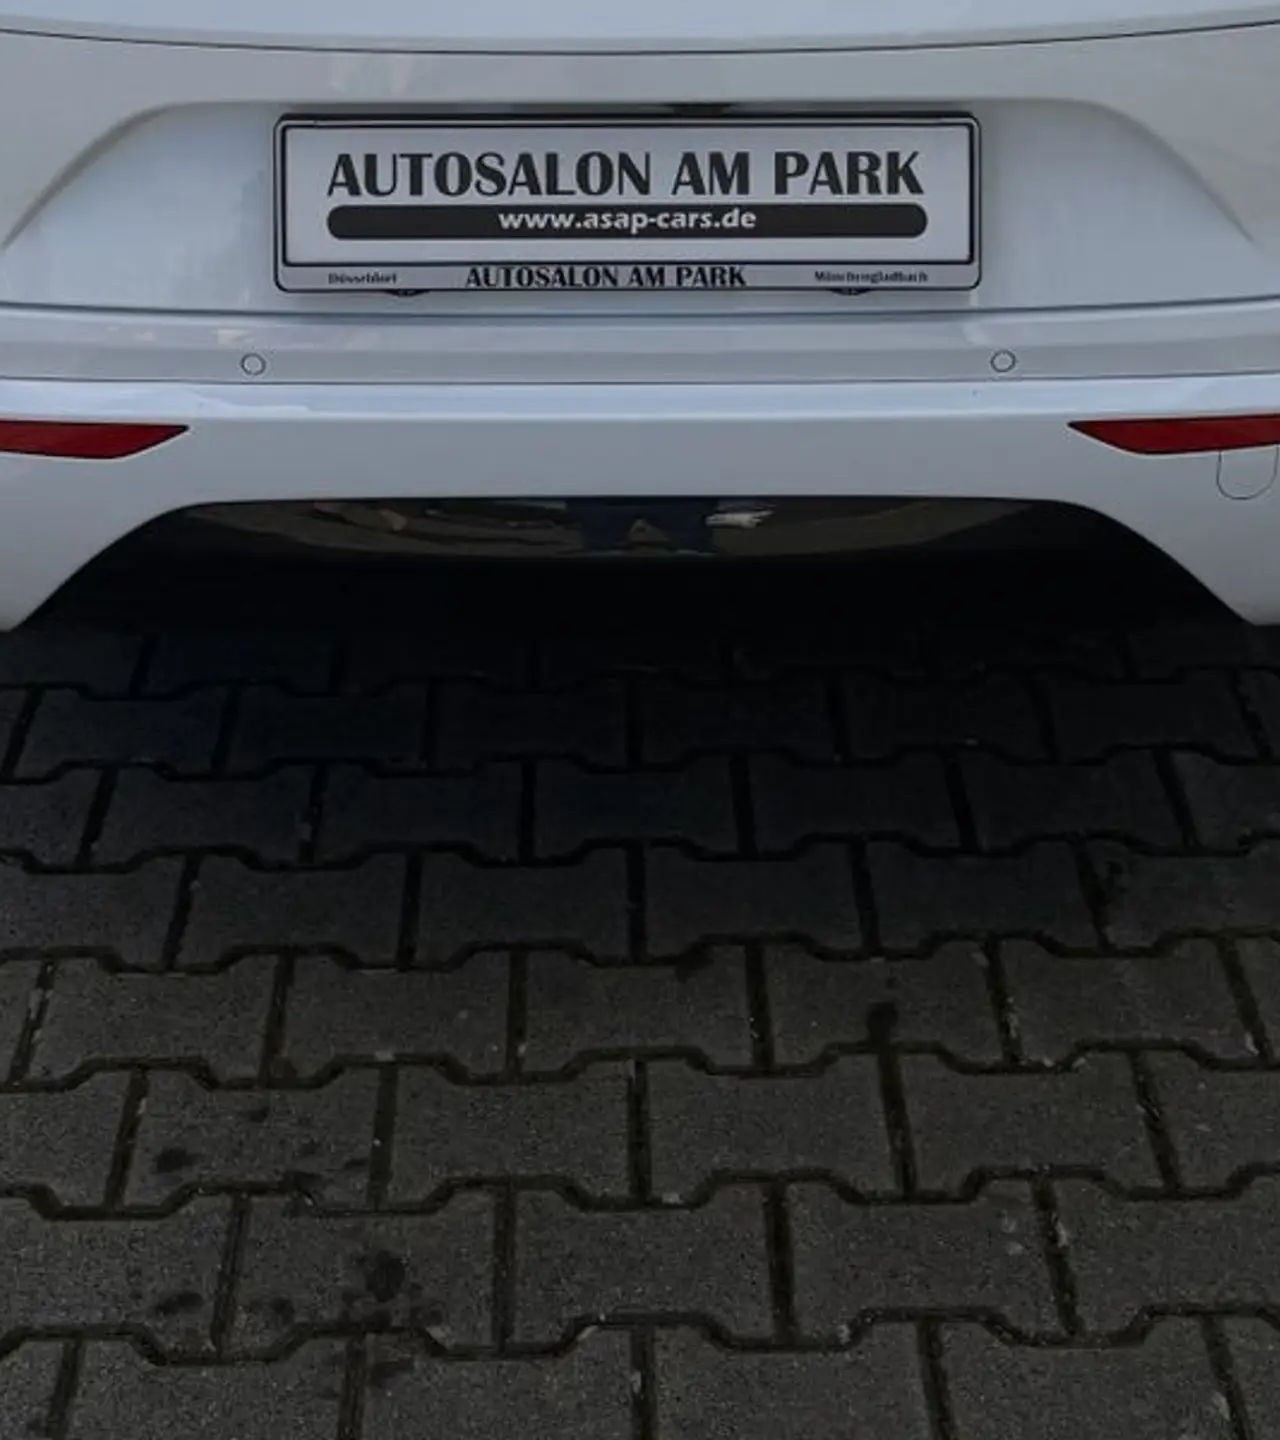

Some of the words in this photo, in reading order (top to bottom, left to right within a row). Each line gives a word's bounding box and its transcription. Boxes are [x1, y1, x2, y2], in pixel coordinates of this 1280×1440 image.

[326, 151, 651, 197] AUTOSALON
[671, 151, 751, 196] AM
[774, 151, 925, 196] PARK
[498, 208, 757, 235] www.asap-cars.de
[465, 265, 619, 288] AUTOSALON
[628, 265, 666, 288] AM
[675, 265, 747, 288] PARK
